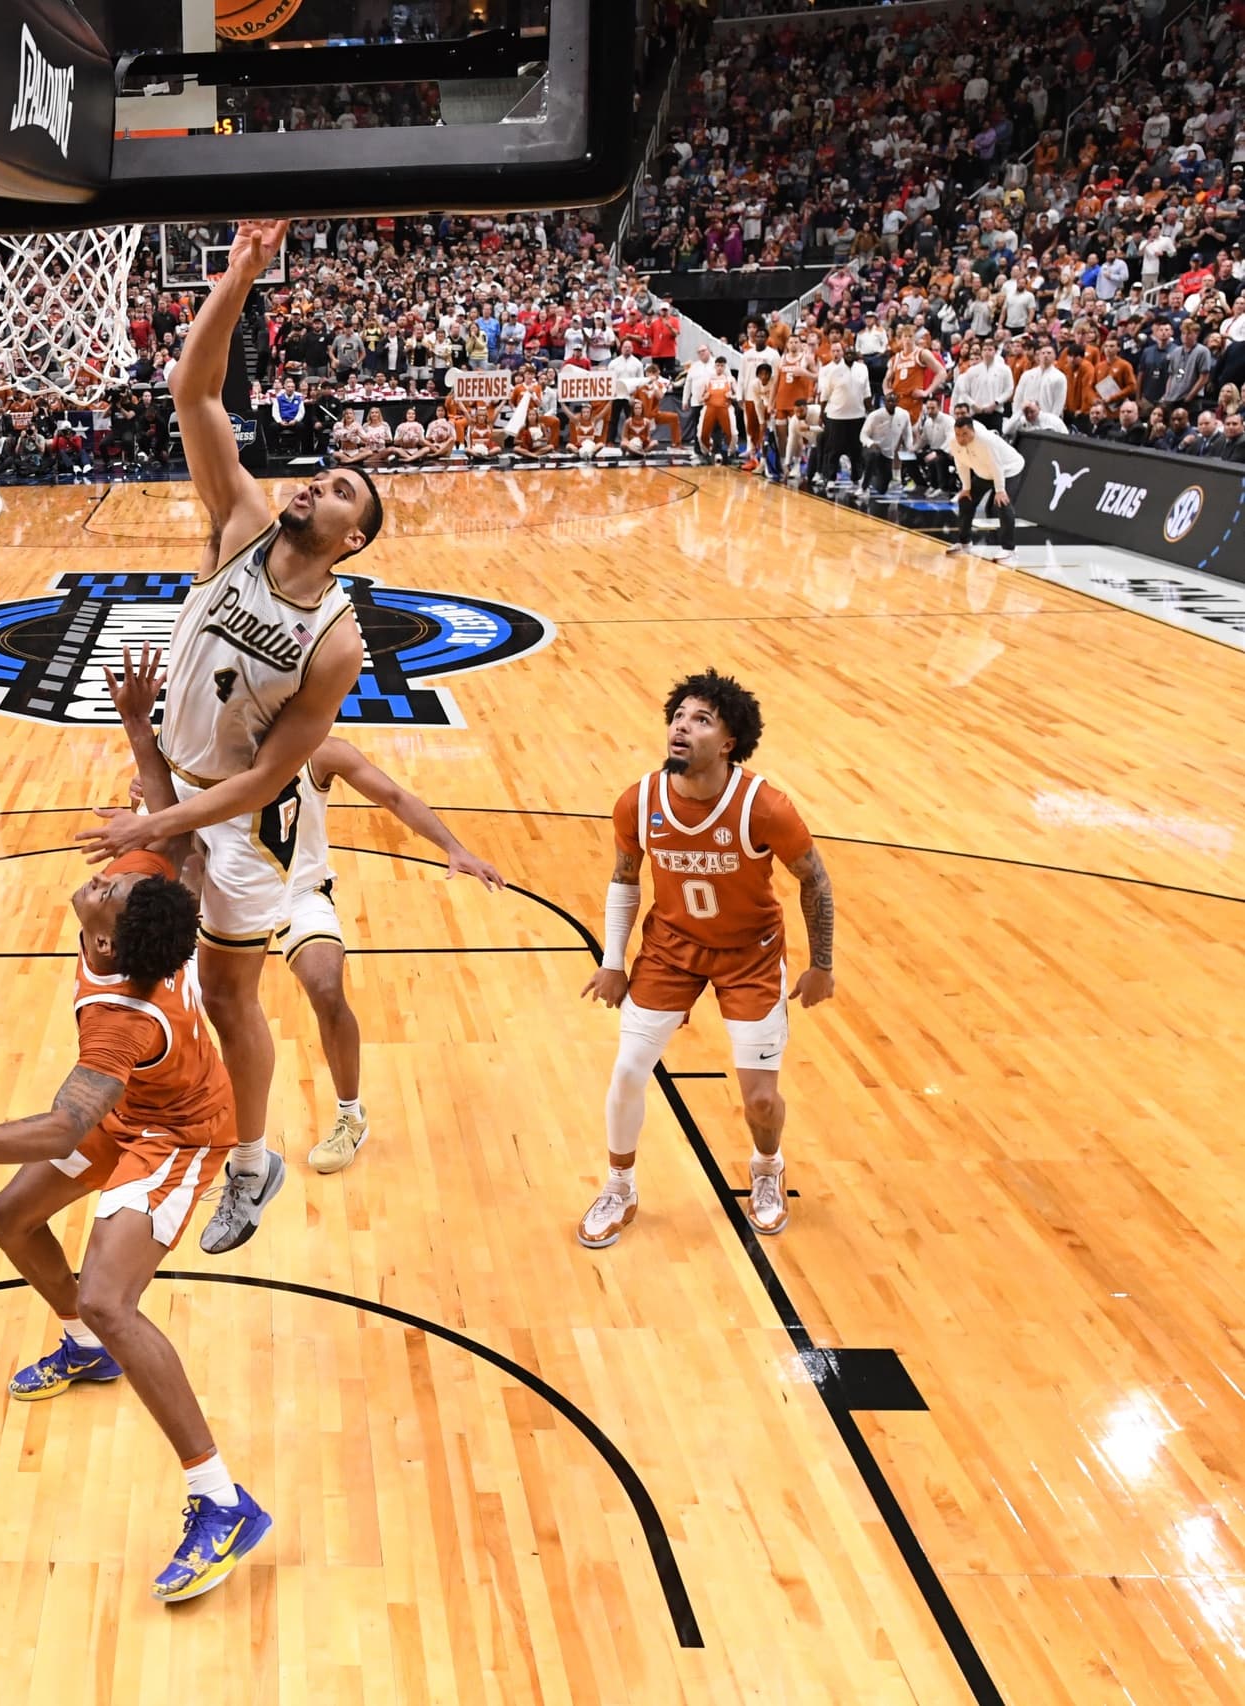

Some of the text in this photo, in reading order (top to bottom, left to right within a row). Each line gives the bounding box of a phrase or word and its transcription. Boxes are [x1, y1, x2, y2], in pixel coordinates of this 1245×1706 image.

[10, 22, 74, 160] SPALDING
[457, 377, 508, 398] DEFENSE
[561, 377, 613, 399] DEFENSE
[1096, 481, 1147, 519] TEXAS
[1167, 490, 1200, 537] SEC
[203, 585, 302, 668] Purdue
[418, 604, 498, 632] SWEET
[214, 667, 238, 703] 4
[651, 848, 740, 875] TEXAS
[681, 879, 720, 919] 0
